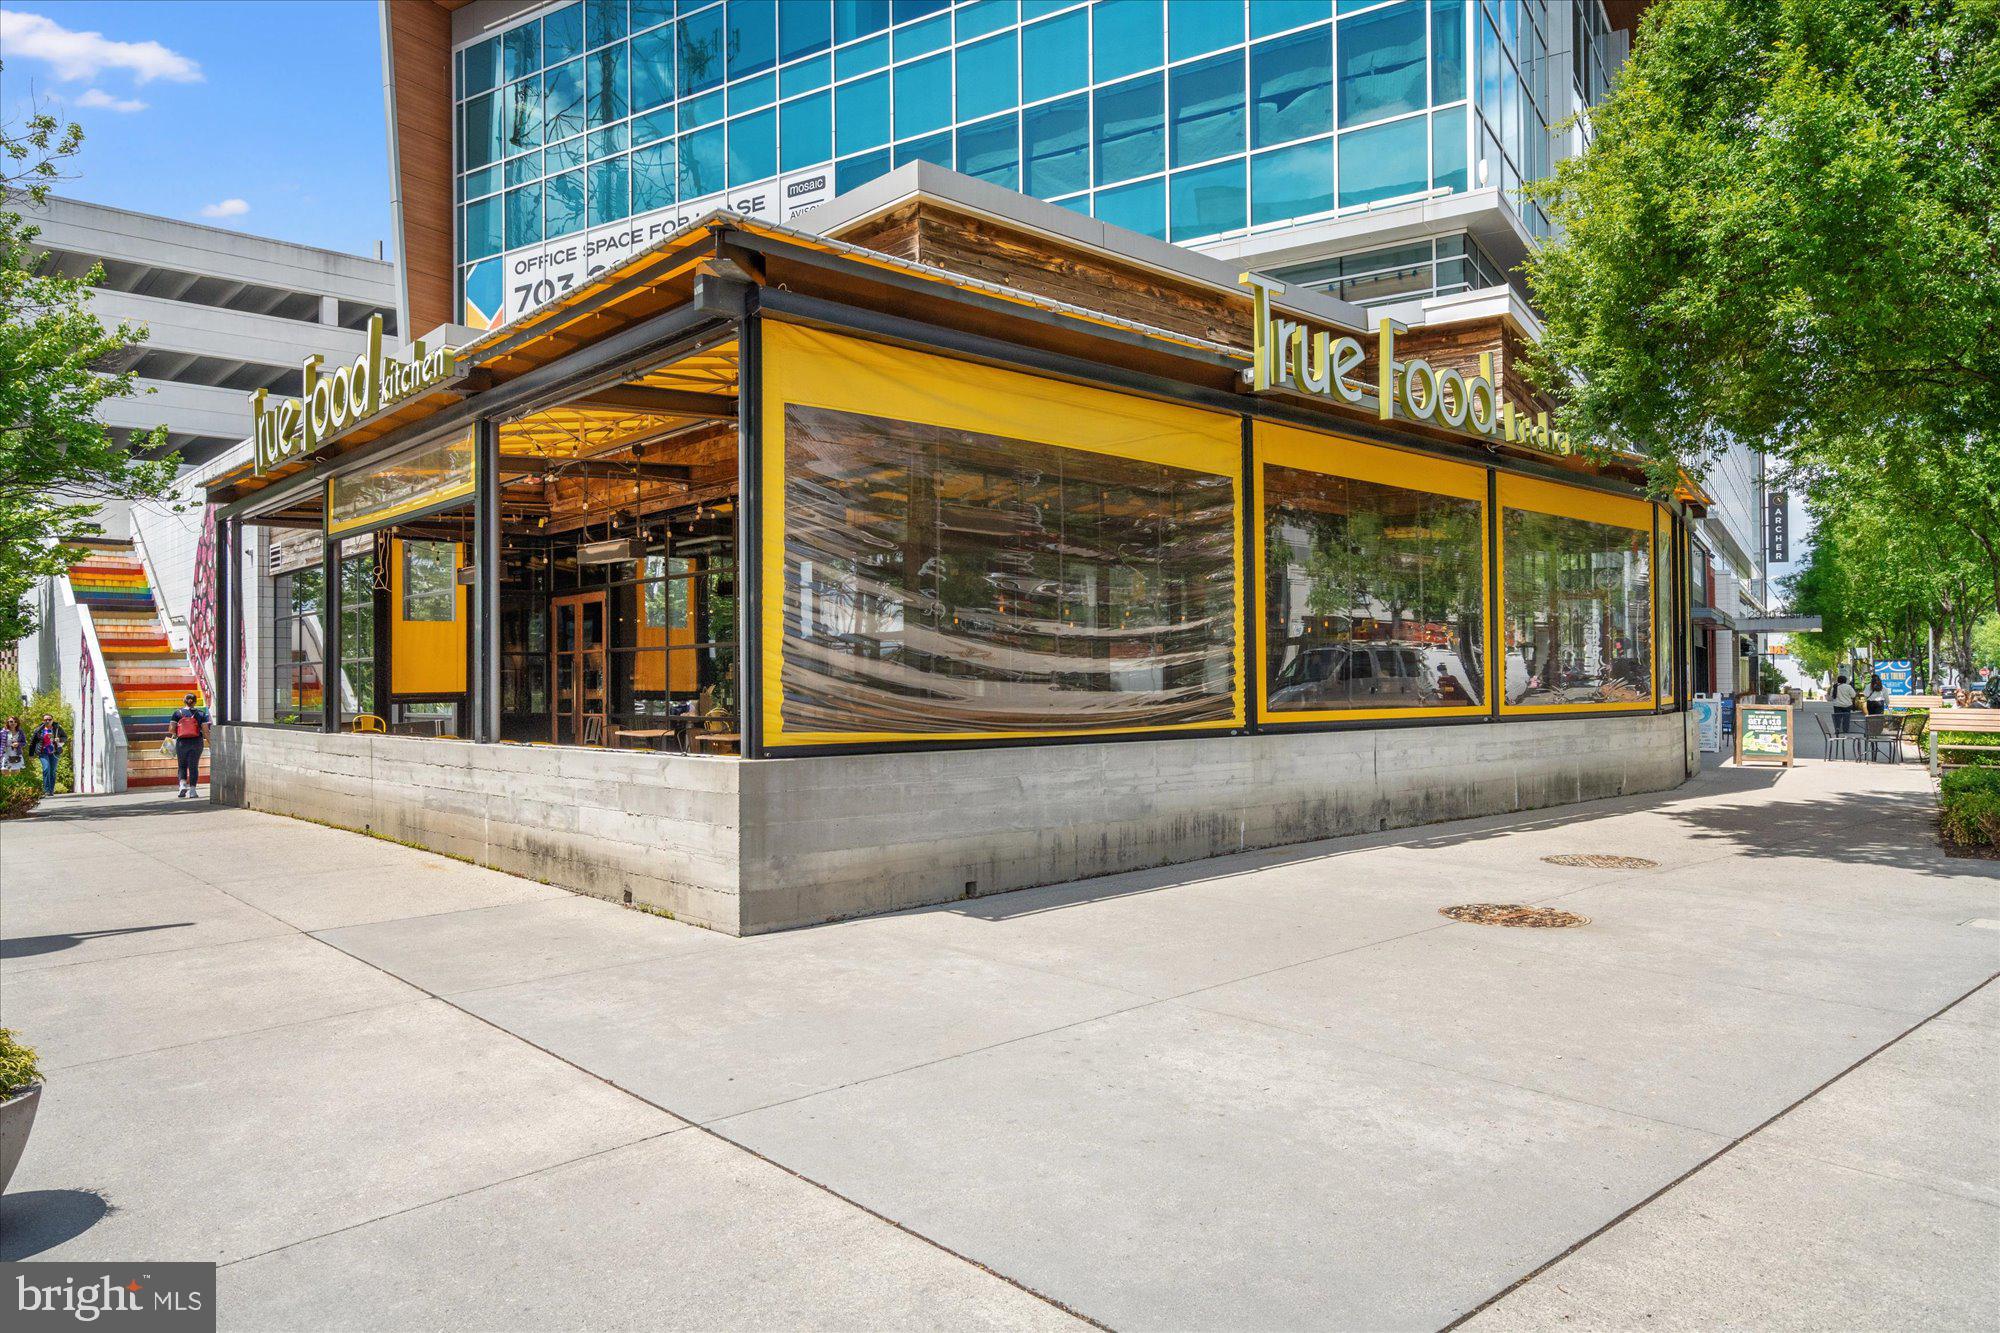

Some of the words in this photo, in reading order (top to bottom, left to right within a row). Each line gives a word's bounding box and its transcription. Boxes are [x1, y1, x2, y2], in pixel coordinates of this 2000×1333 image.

[789, 179, 824, 196] mosaic
[790, 203, 824, 220] AVISO
[514, 247, 577, 275] OFFICE
[583, 228, 643, 257] SPACE
[649, 216, 689, 240] FOR
[514, 273, 574, 313] 703
[1238, 271, 1366, 402] True
[1379, 317, 1496, 436] Food
[249, 388, 301, 477] True
[303, 313, 383, 452] Food
[381, 340, 454, 404] kitchen
[1774, 508, 1783, 560] ARCHER
